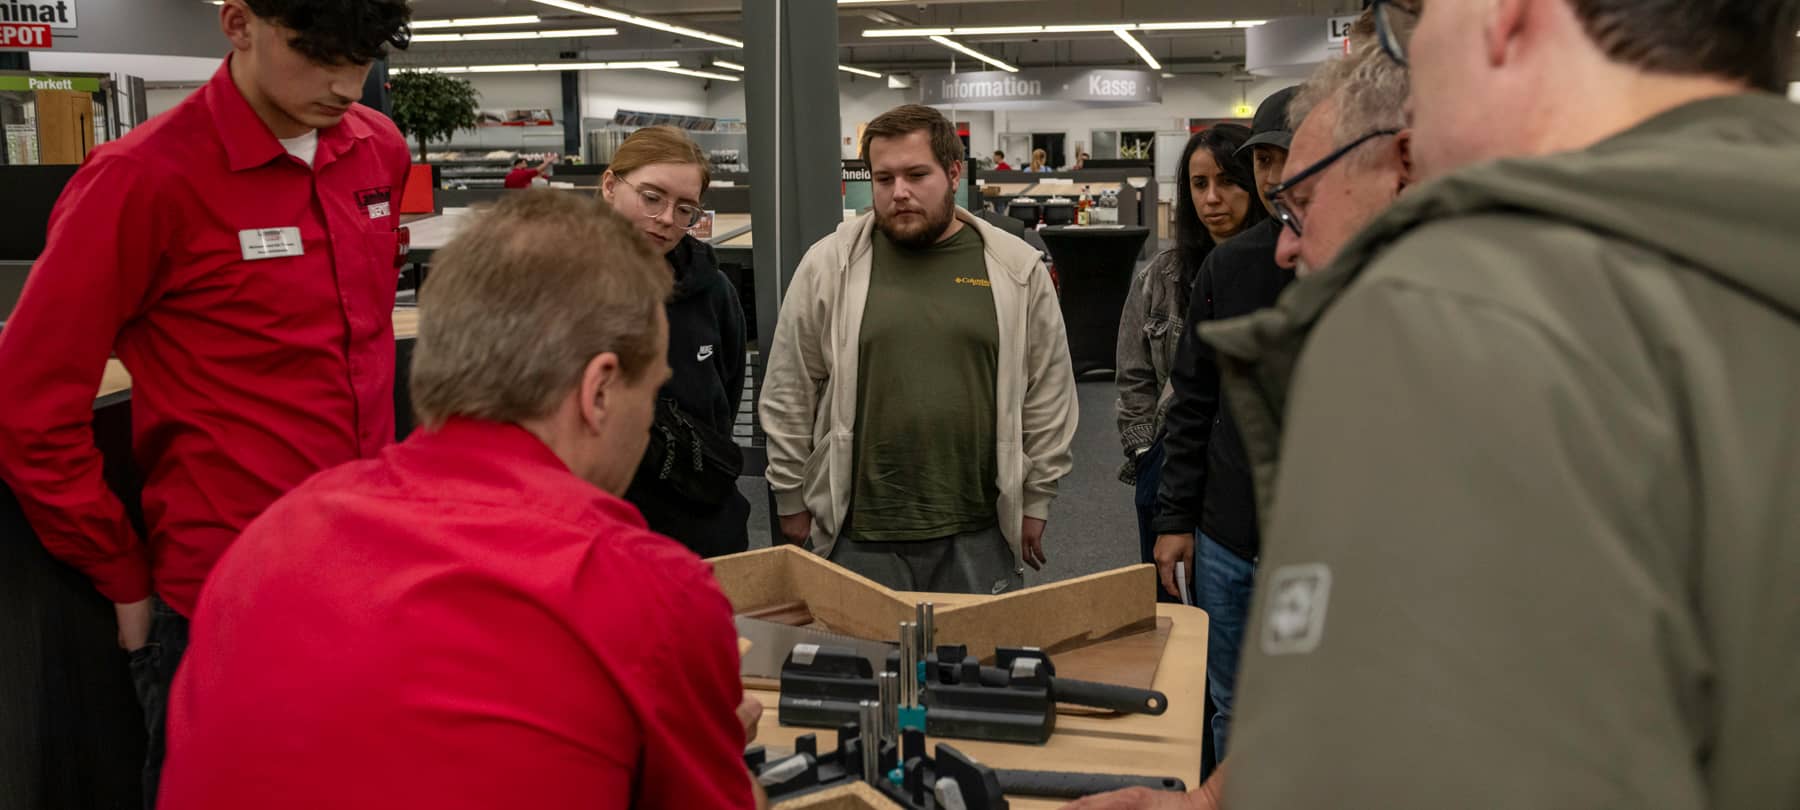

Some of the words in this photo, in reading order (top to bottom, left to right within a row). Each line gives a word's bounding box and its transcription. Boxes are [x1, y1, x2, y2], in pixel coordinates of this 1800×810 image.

[28, 78, 72, 89] Parkett
[942, 76, 1041, 98] Information
[1089, 75, 1137, 96] Kasse
